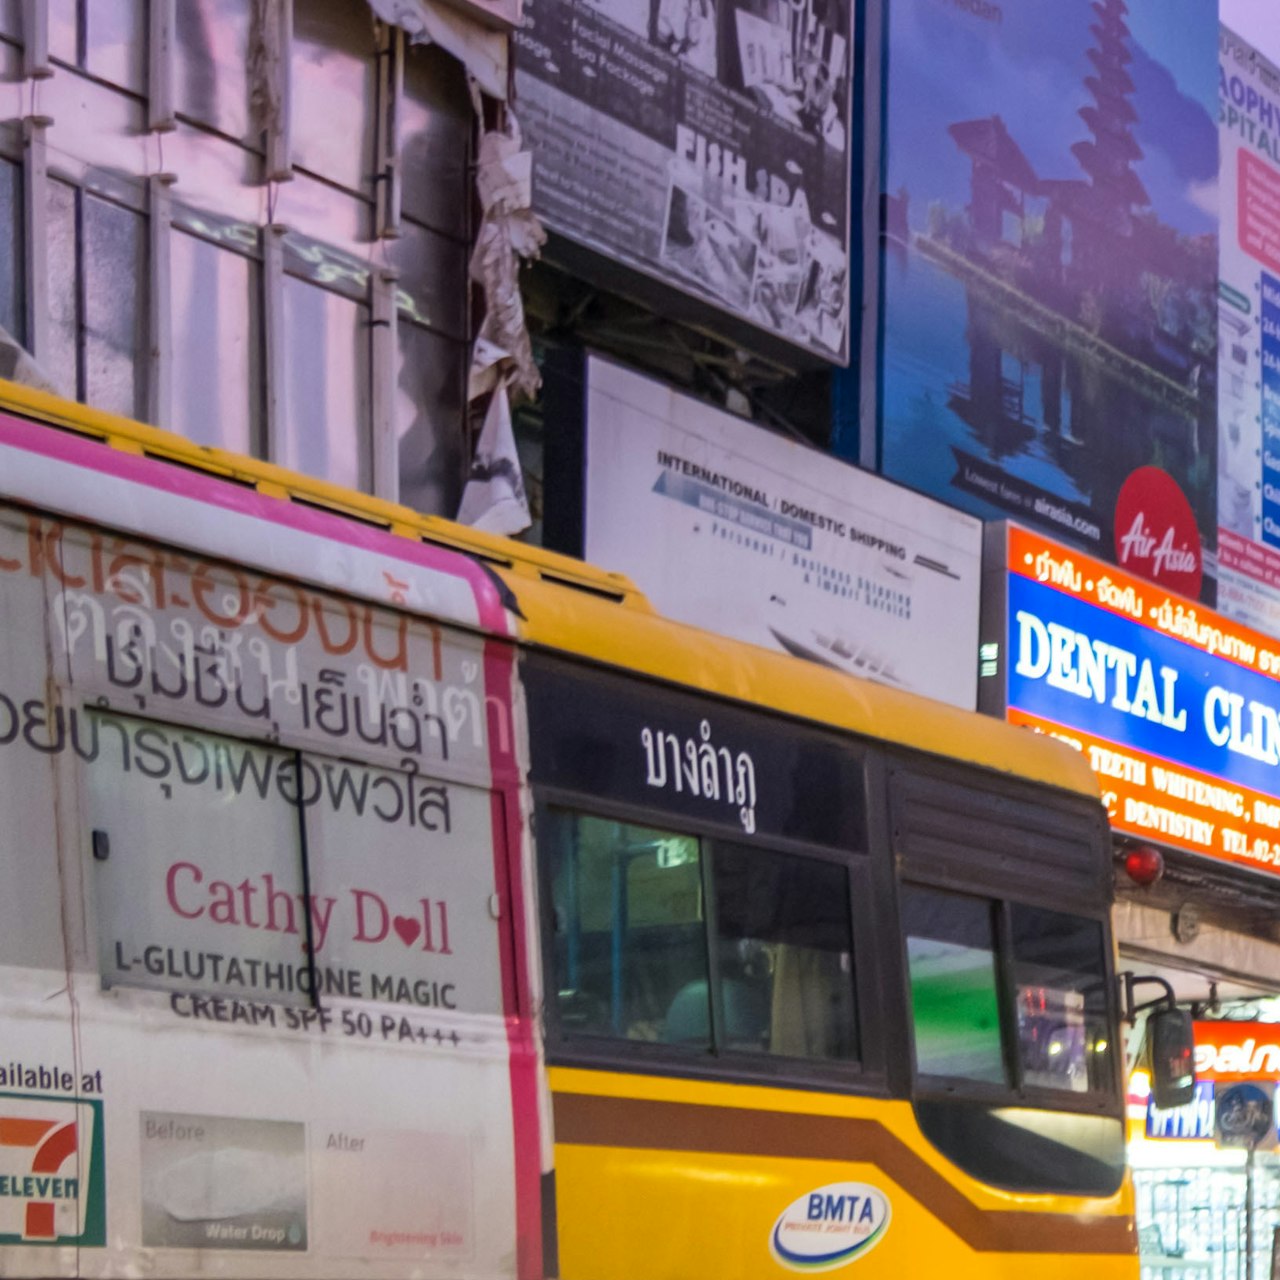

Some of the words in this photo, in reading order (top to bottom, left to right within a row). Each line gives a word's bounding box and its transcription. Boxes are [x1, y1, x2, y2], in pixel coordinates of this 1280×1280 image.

[676, 123, 747, 190] FISH
[755, 168, 812, 225] SPA
[657, 450, 770, 508] INTERNATIONAL
[780, 500, 846, 539] DOMESTIC
[849, 527, 906, 561] SHIPPING
[1034, 498, 1101, 541] airasia.com
[1120, 512, 1157, 563] Air
[1152, 527, 1197, 577] Asia
[1015, 610, 1187, 733] DENTAL
[1087, 745, 1147, 787] TEETH
[1124, 798, 1215, 846] DENTISTRY
[166, 860, 338, 956] Cathy
[114, 941, 363, 999] L-GLUTATHIONE
[371, 973, 457, 1010] MAGIC
[169, 993, 277, 1030] CREAM
[285, 1004, 334, 1035] SPF
[341, 1008, 373, 1039] 50
[380, 1015, 461, 1047] PA+++
[81, 1070, 103, 1093] at
[145, 1120, 206, 1141] Before
[326, 1133, 365, 1153] After
[807, 1193, 873, 1223] BMTA
[205, 1223, 249, 1241] Water
[251, 1224, 286, 1243] Drop
